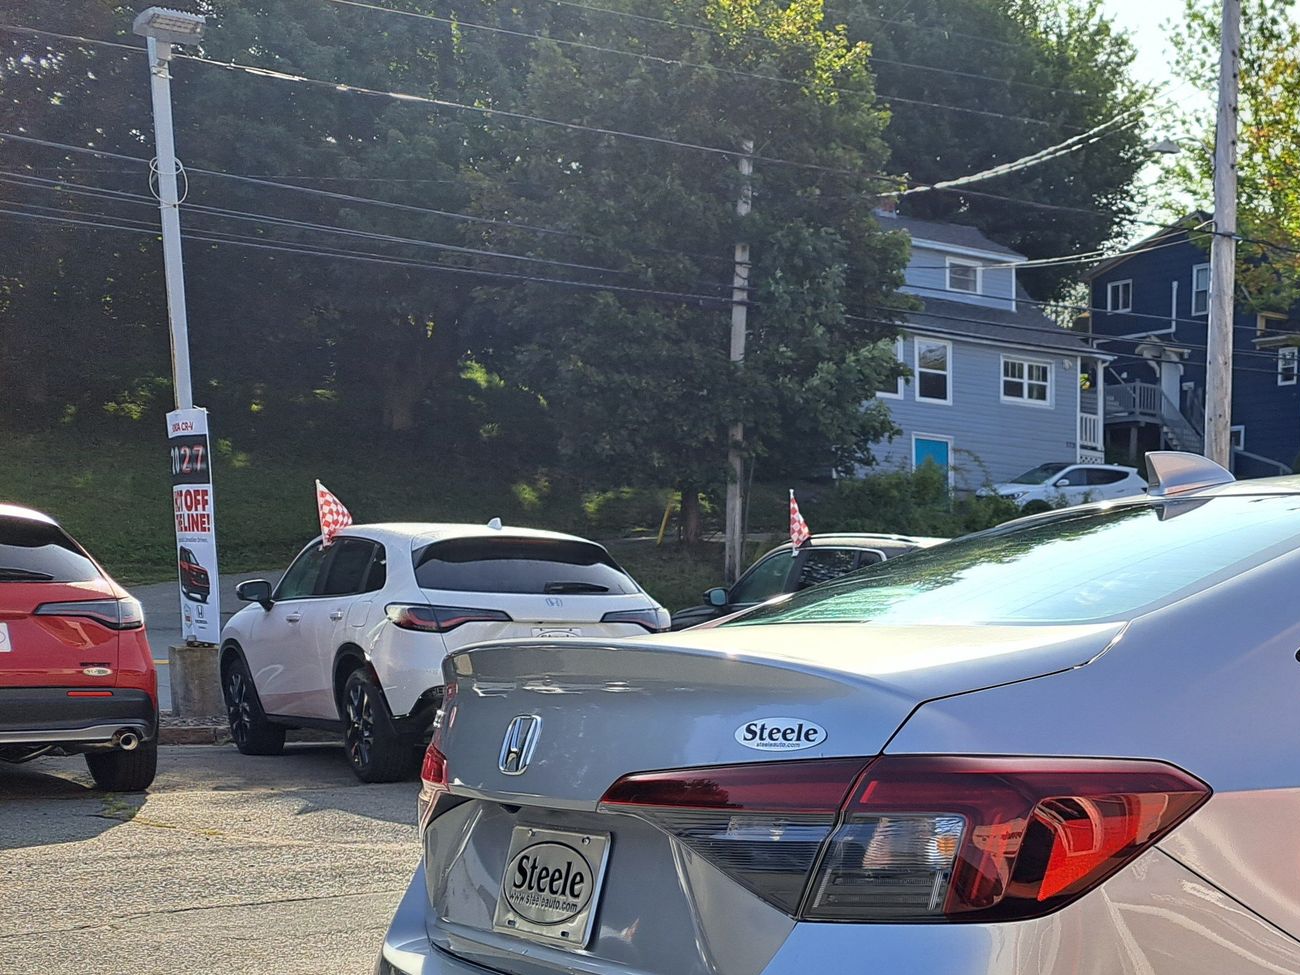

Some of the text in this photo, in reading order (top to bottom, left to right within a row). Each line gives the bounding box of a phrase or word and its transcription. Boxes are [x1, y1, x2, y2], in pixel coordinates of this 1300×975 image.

[184, 489, 209, 512] OFF
[743, 723, 818, 742] Steele
[513, 854, 585, 898] Steele
[509, 891, 578, 912] www.steeleauto.com
